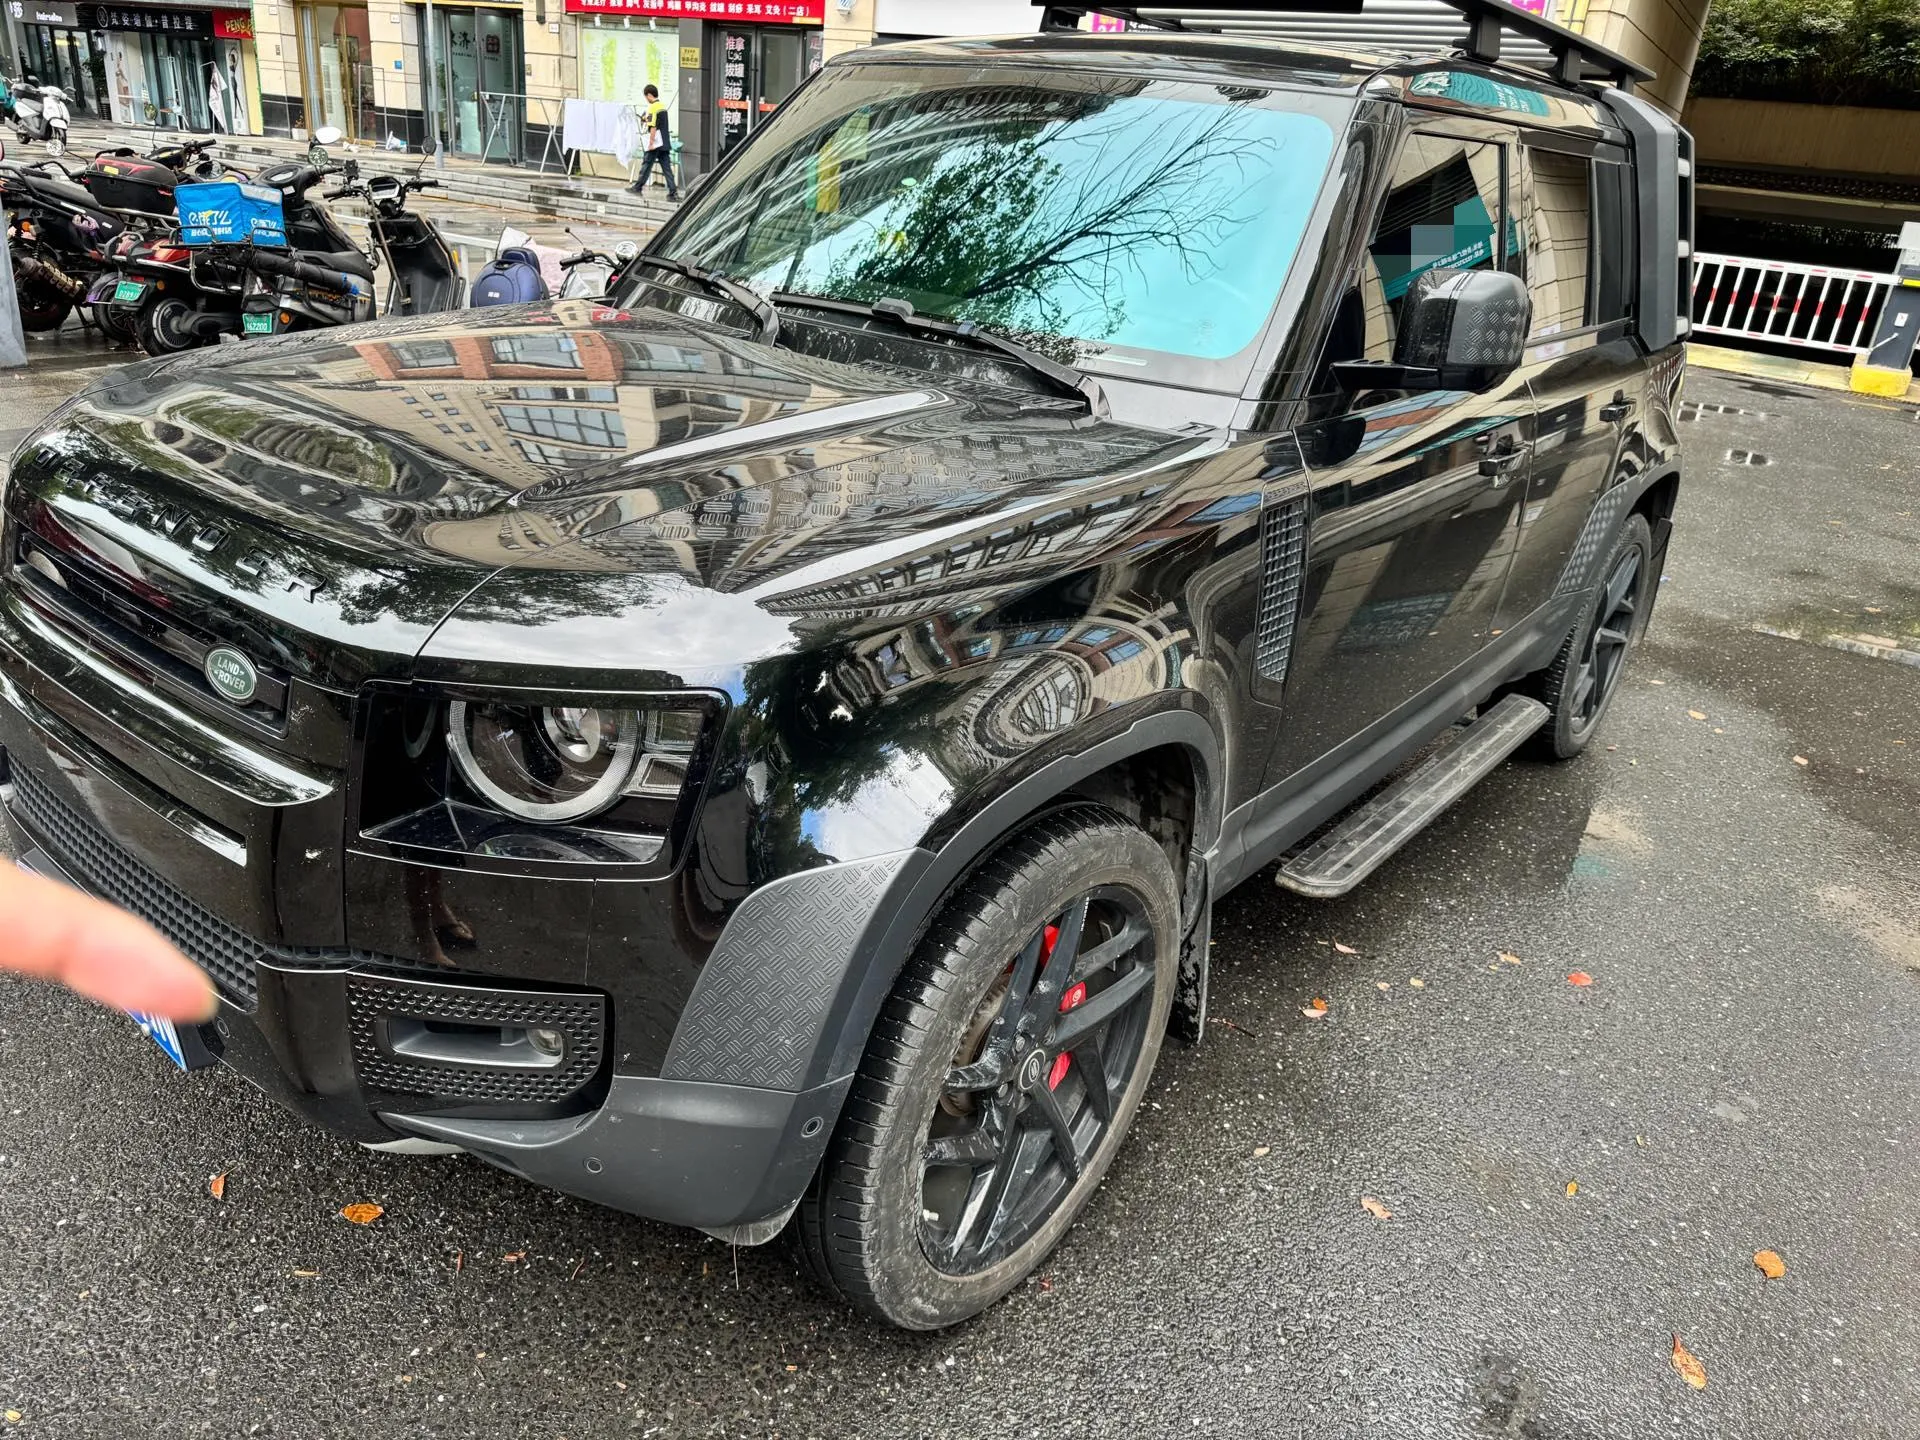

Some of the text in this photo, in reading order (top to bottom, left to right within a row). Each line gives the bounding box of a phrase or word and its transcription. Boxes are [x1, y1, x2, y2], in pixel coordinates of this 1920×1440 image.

[725, 36, 745, 51] 推拿
[725, 63, 745, 78] 拔罐
[723, 86, 743, 100] 刮痧
[722, 111, 741, 126] 按摩
[32, 447, 328, 604] DEFENDER
[217, 655, 240, 676] LAND
[217, 669, 246, 692] ROVER
